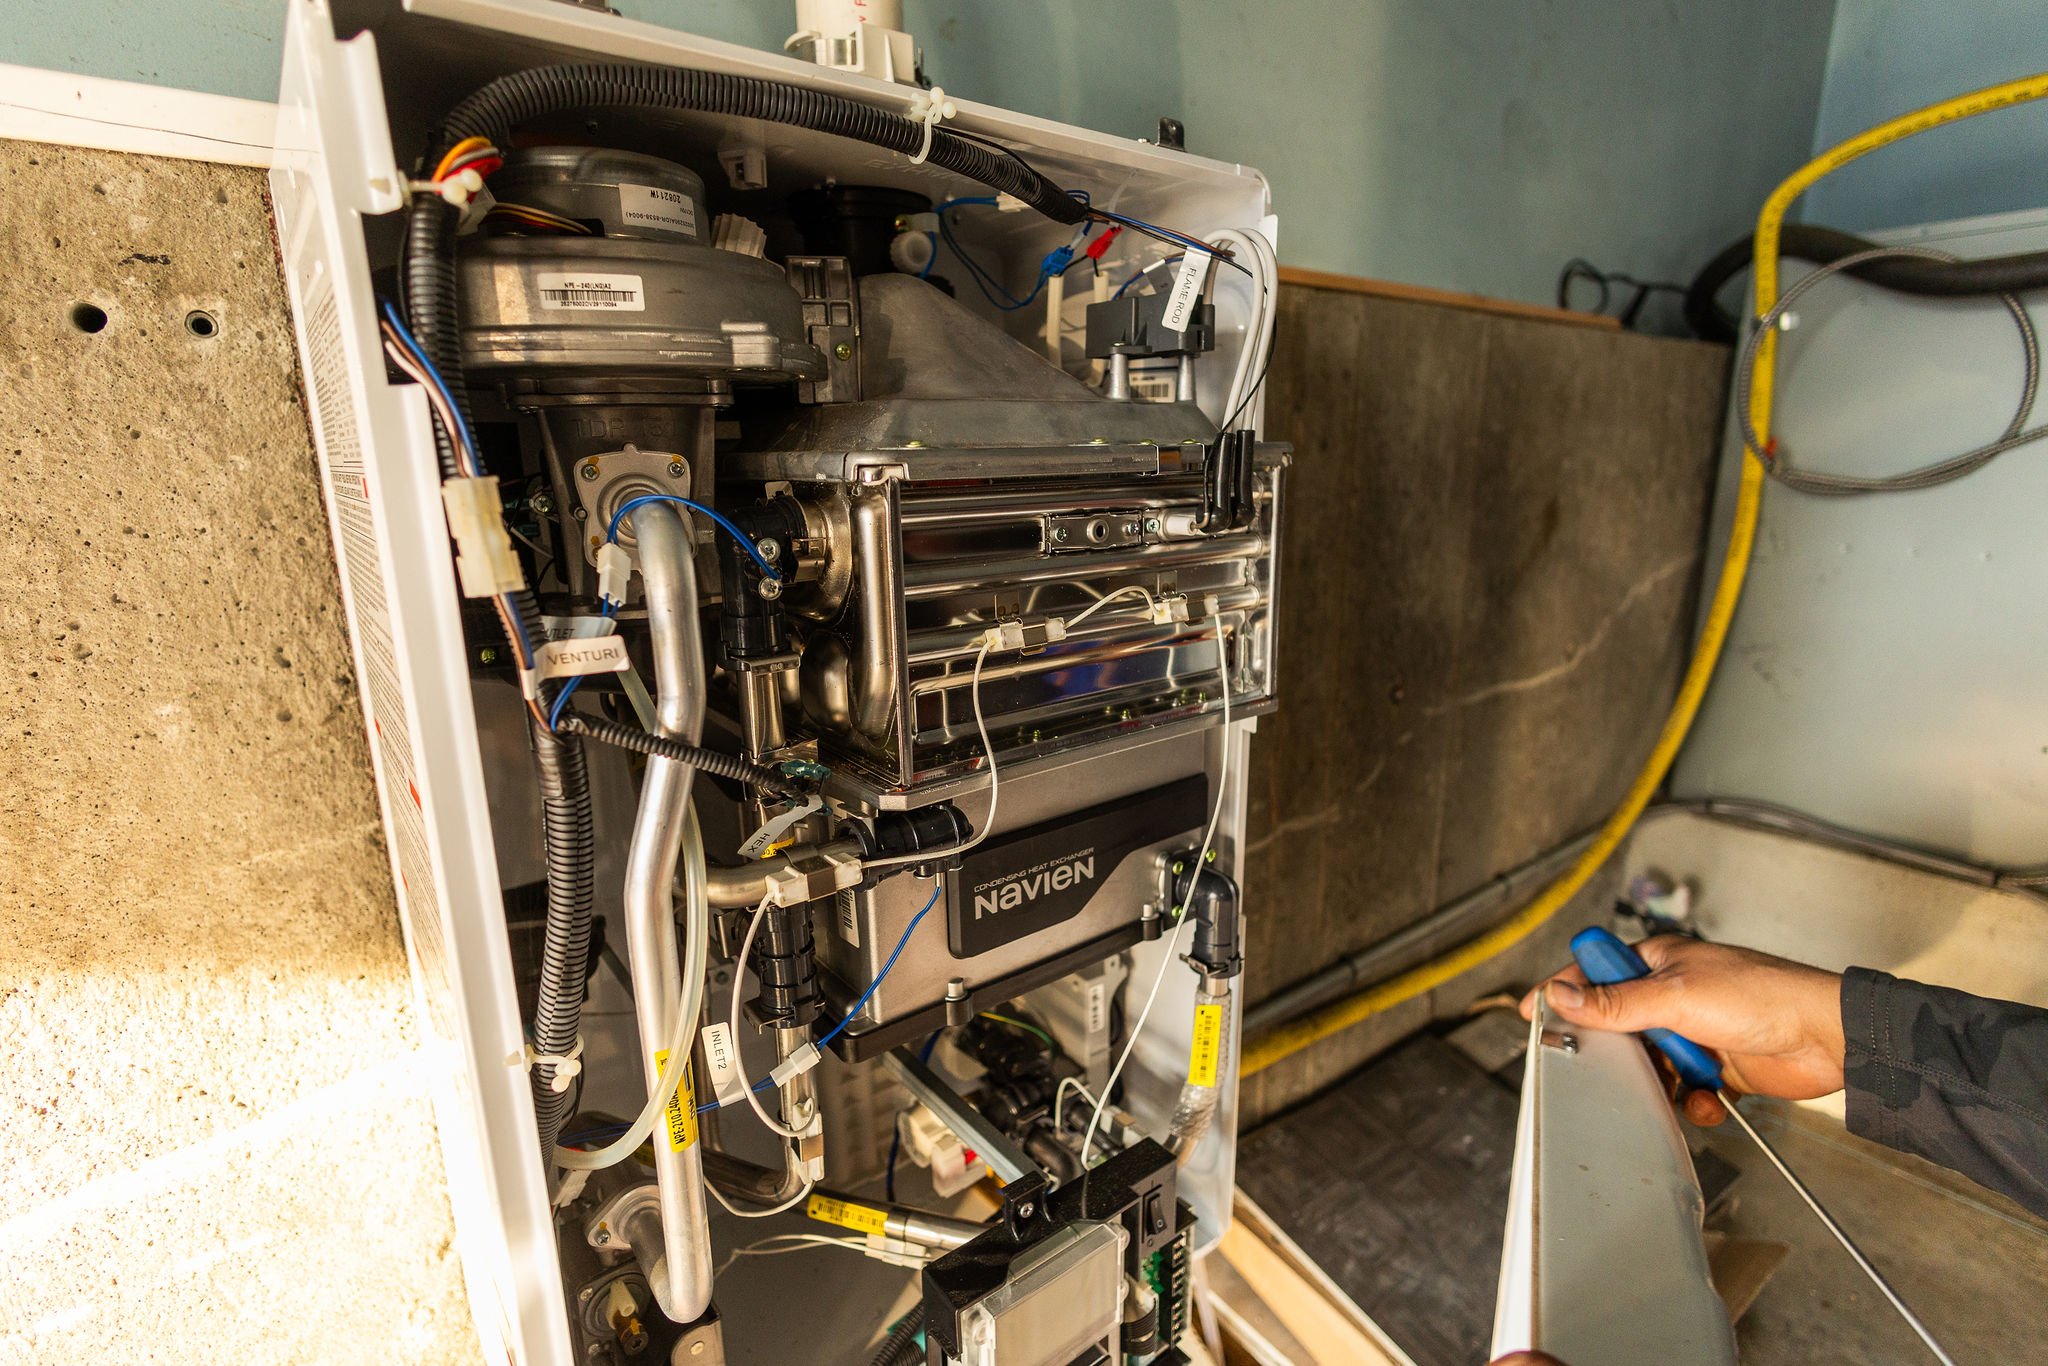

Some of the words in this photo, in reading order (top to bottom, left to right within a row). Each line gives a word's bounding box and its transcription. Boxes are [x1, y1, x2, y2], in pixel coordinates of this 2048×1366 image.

[1178, 267, 1197, 302] FLAME
[1171, 301, 1185, 324] ROD
[545, 628, 576, 640] UTLET
[547, 648, 620, 665] VENTURI
[747, 832, 771, 853] HEX
[973, 869, 1027, 893] CONDENSING
[1028, 862, 1049, 876] HEAT
[1049, 847, 1095, 868] EXCHANGER
[711, 1030, 728, 1070] INLET2
